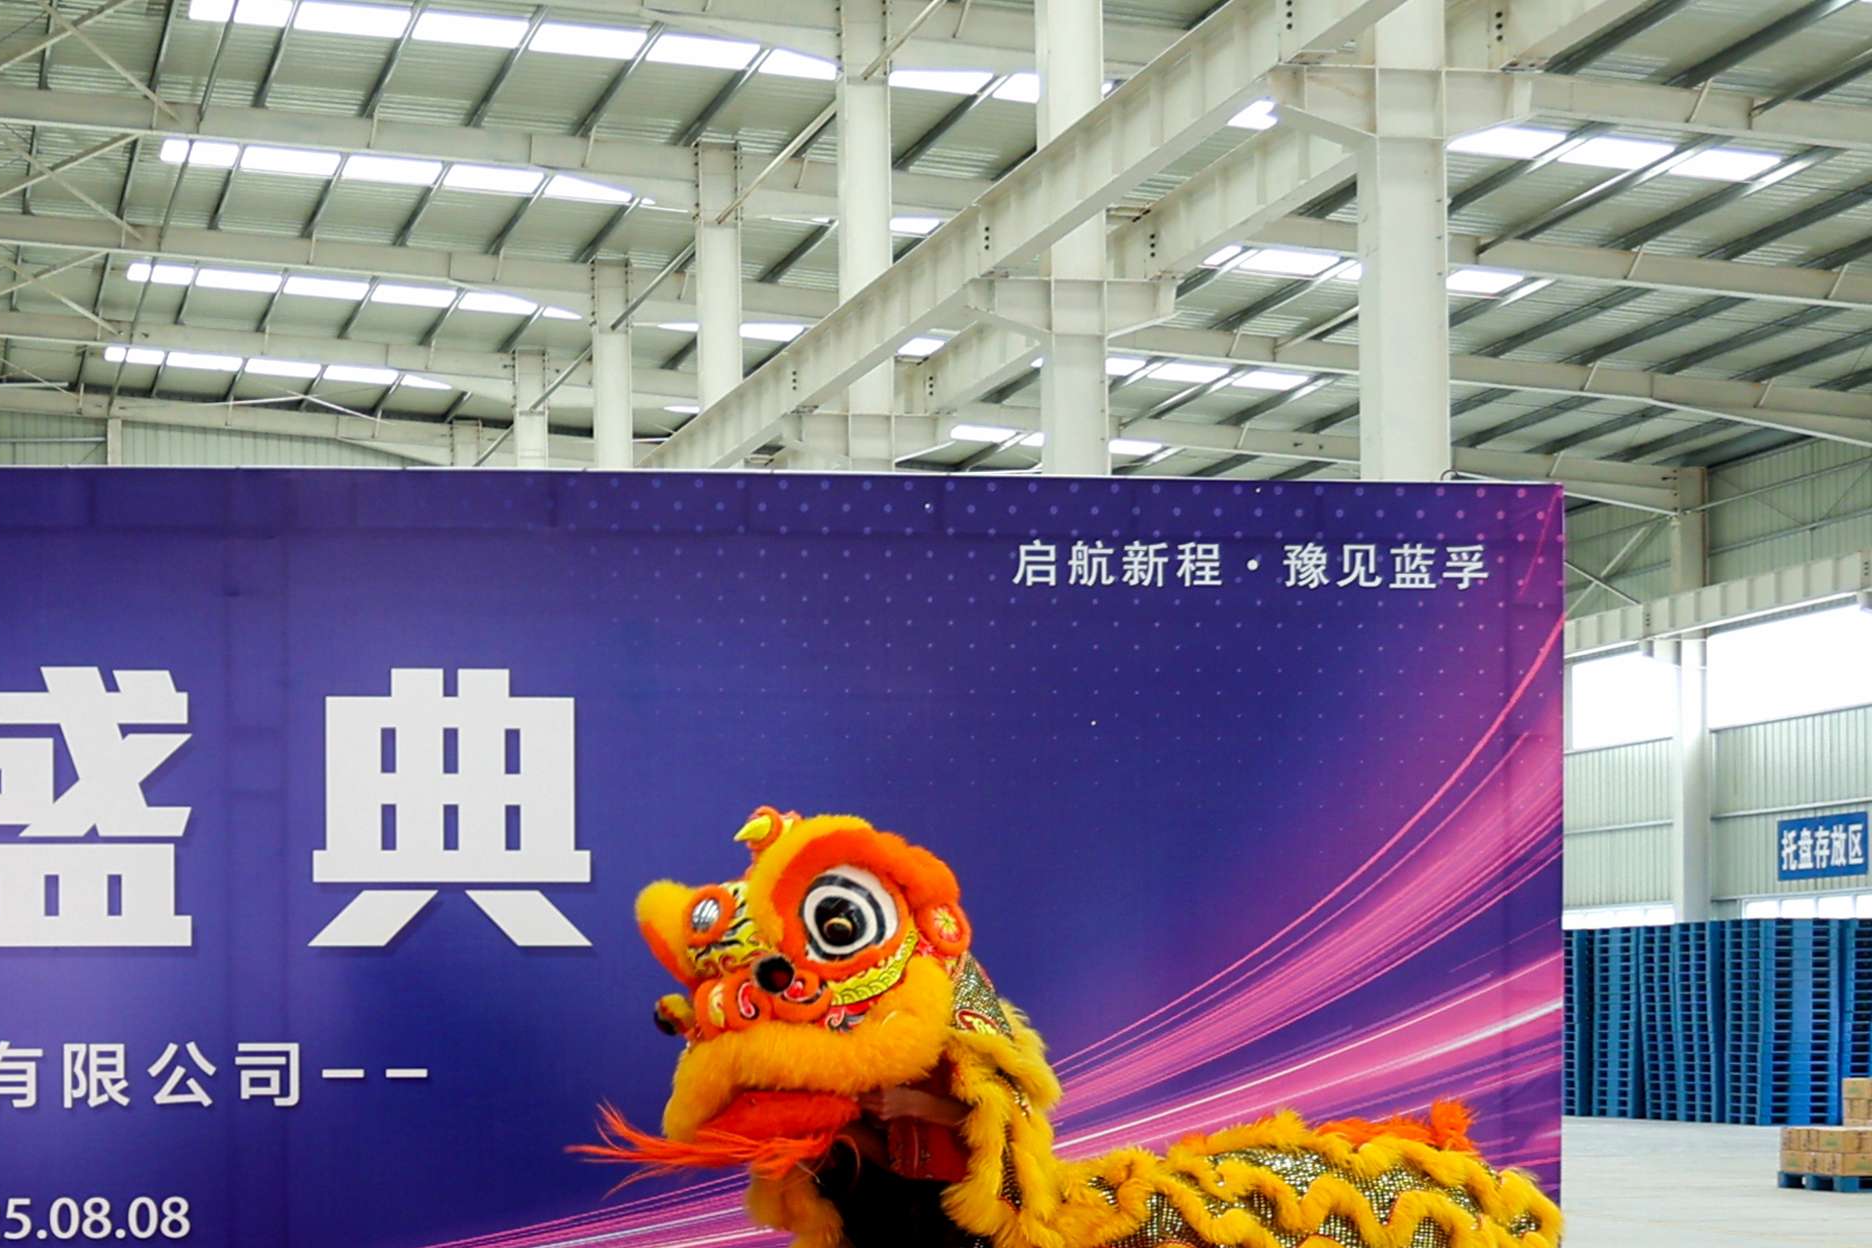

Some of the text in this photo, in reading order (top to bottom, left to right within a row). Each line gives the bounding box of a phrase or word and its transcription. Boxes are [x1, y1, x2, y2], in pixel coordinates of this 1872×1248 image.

[1781, 823, 1865, 871] 托盘存放区
